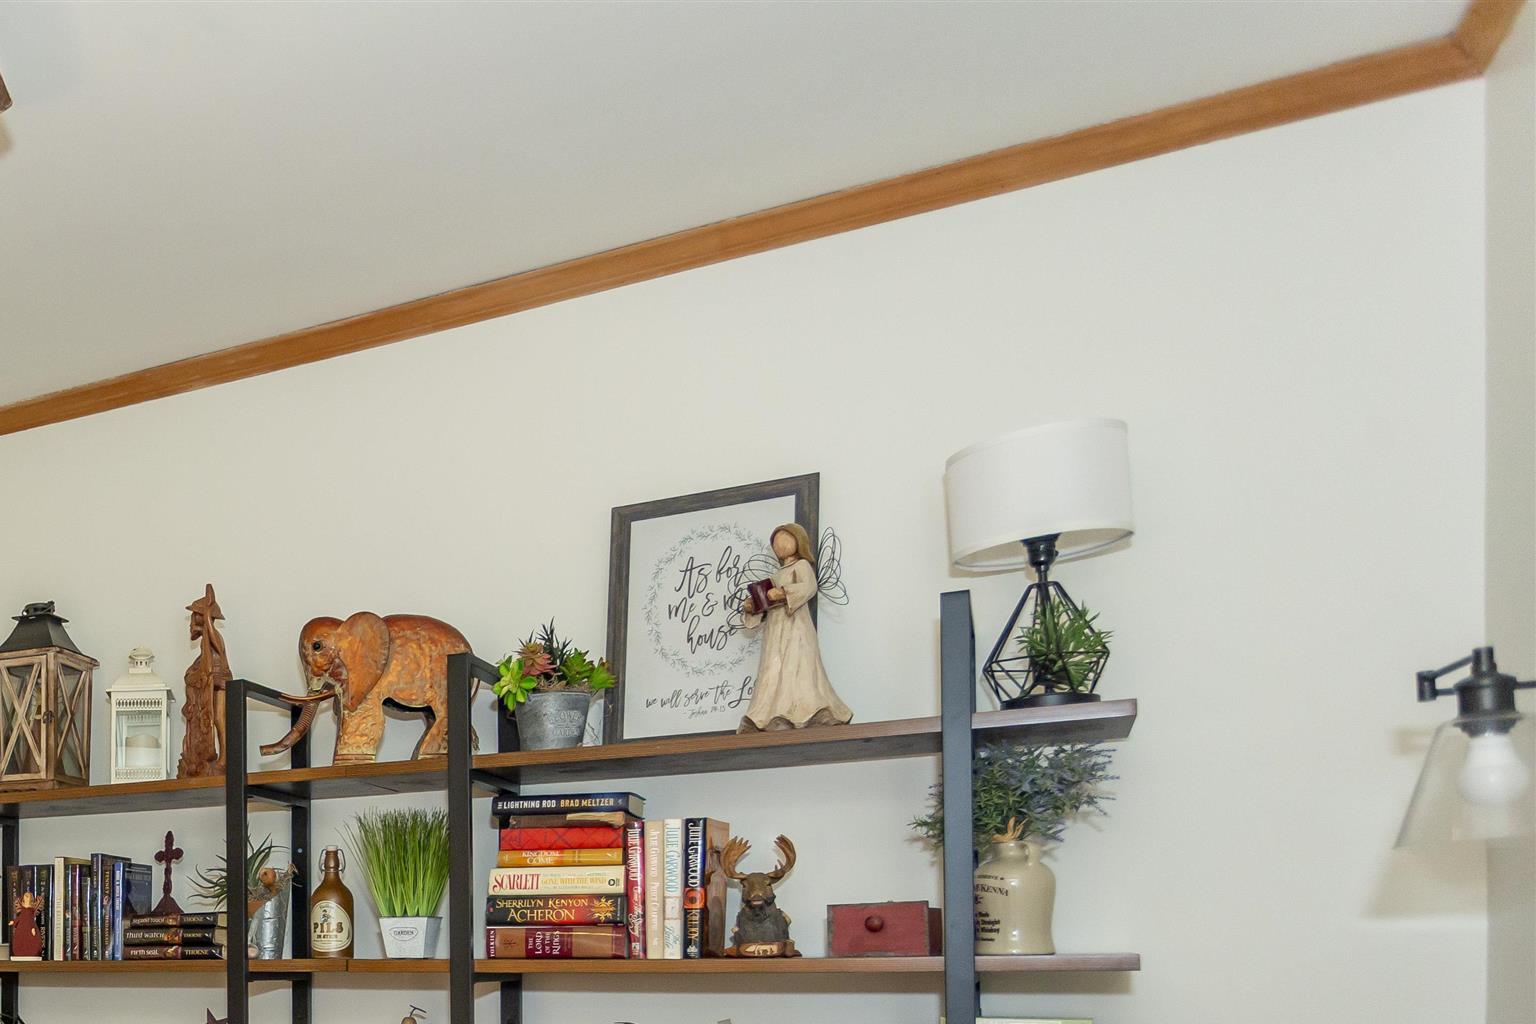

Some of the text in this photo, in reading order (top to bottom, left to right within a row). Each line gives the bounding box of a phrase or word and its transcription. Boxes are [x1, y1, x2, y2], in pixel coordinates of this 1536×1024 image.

[674, 556, 712, 599] As
[668, 597, 696, 623] me
[702, 592, 718, 617] &
[687, 615, 737, 655] house
[660, 689, 682, 708] will
[683, 688, 710, 707] serve
[727, 676, 754, 709] Lo
[503, 800, 540, 809] LIGHTNING
[542, 799, 556, 808] ROD
[560, 799, 579, 808] BRAD
[581, 798, 614, 807] MELTZER
[626, 828, 641, 846] JULIE
[688, 823, 702, 845] JULIE
[626, 846, 641, 881] GARWOOD
[665, 824, 680, 893] JULIE GARWOOD
[688, 846, 701, 887] GARWOOD
[492, 873, 541, 893] SCARLETT
[496, 898, 589, 909] SHERRILYN KENYON
[507, 908, 575, 923] ACHERON
[313, 922, 344, 934] PILS
[535, 931, 544, 954] LORD
[545, 945, 551, 954] OF
[552, 930, 561, 955] RINGS
